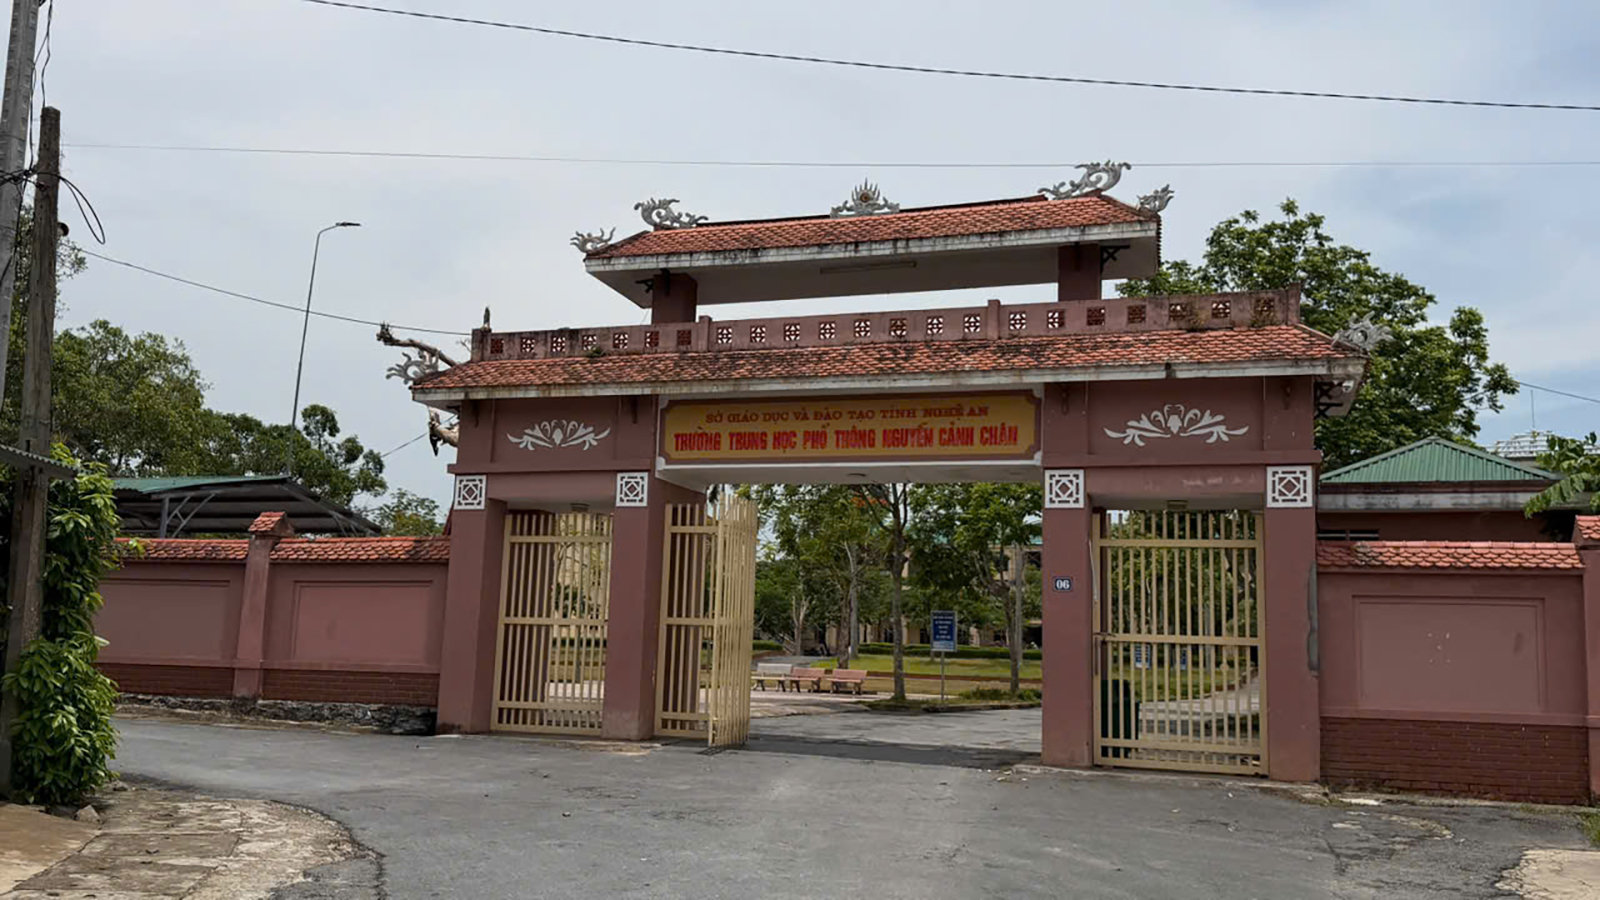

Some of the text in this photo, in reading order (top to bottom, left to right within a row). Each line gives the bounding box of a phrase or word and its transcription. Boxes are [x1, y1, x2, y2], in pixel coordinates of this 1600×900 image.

[705, 410, 723, 424] SỞ
[727, 409, 759, 423] GIÁO
[762, 412, 789, 425] DỤC
[793, 407, 809, 421] VÀ
[813, 407, 843, 421] ĐÀO
[848, 409, 875, 422] TẠO
[967, 406, 989, 417] AN
[674, 426, 721, 451] TRƯỜNG
[728, 430, 768, 450] TRUNG
[772, 429, 797, 453] HỌC
[802, 422, 828, 449] PHỔ
[834, 425, 876, 449] THÔNG
[882, 422, 934, 448] NGUYỄN
[939, 421, 975, 446] CẢNH
[1056, 579, 1070, 589] 06
